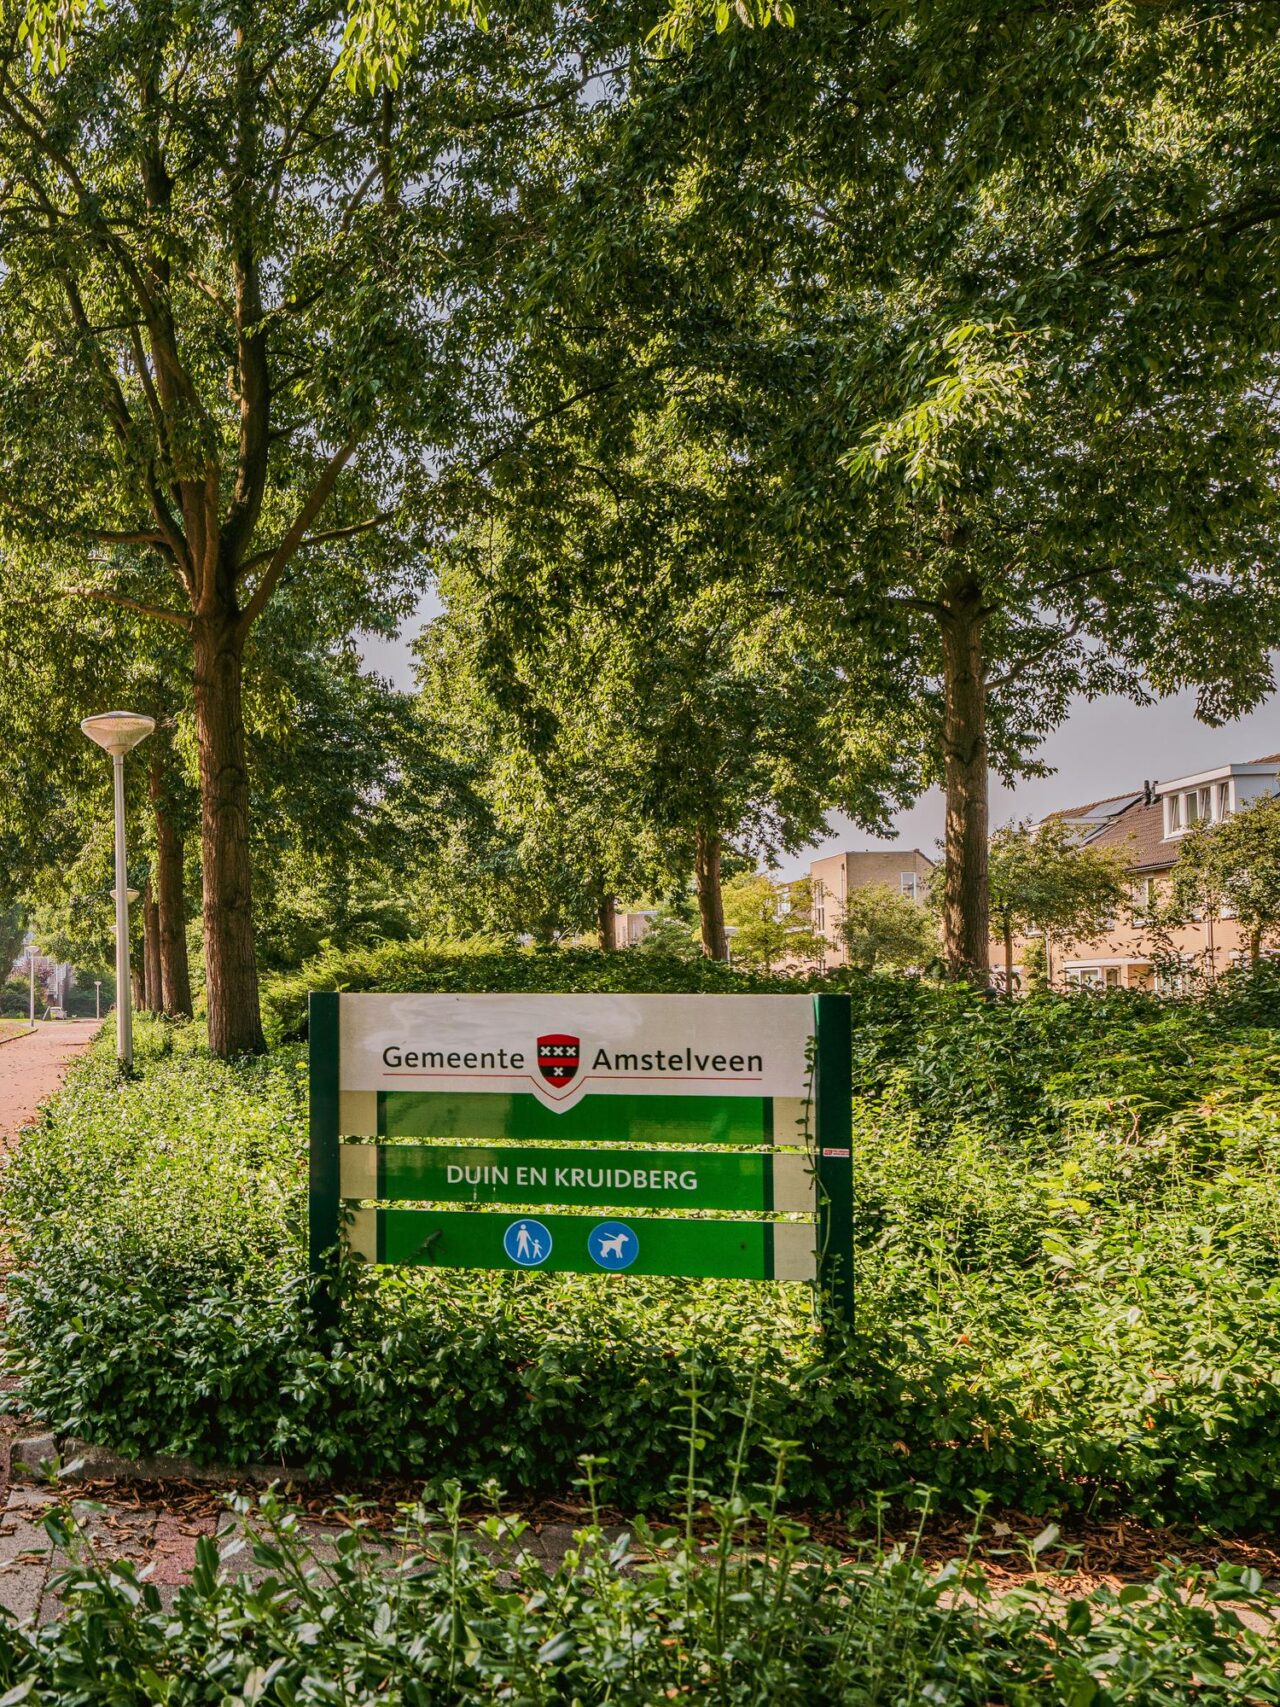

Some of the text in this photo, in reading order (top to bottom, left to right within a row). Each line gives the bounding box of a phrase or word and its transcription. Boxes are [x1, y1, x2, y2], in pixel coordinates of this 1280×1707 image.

[382, 1046, 763, 1072] Gemeente Amstelveen
[447, 1165, 698, 1190] DUIN EN KRUIDBERG
